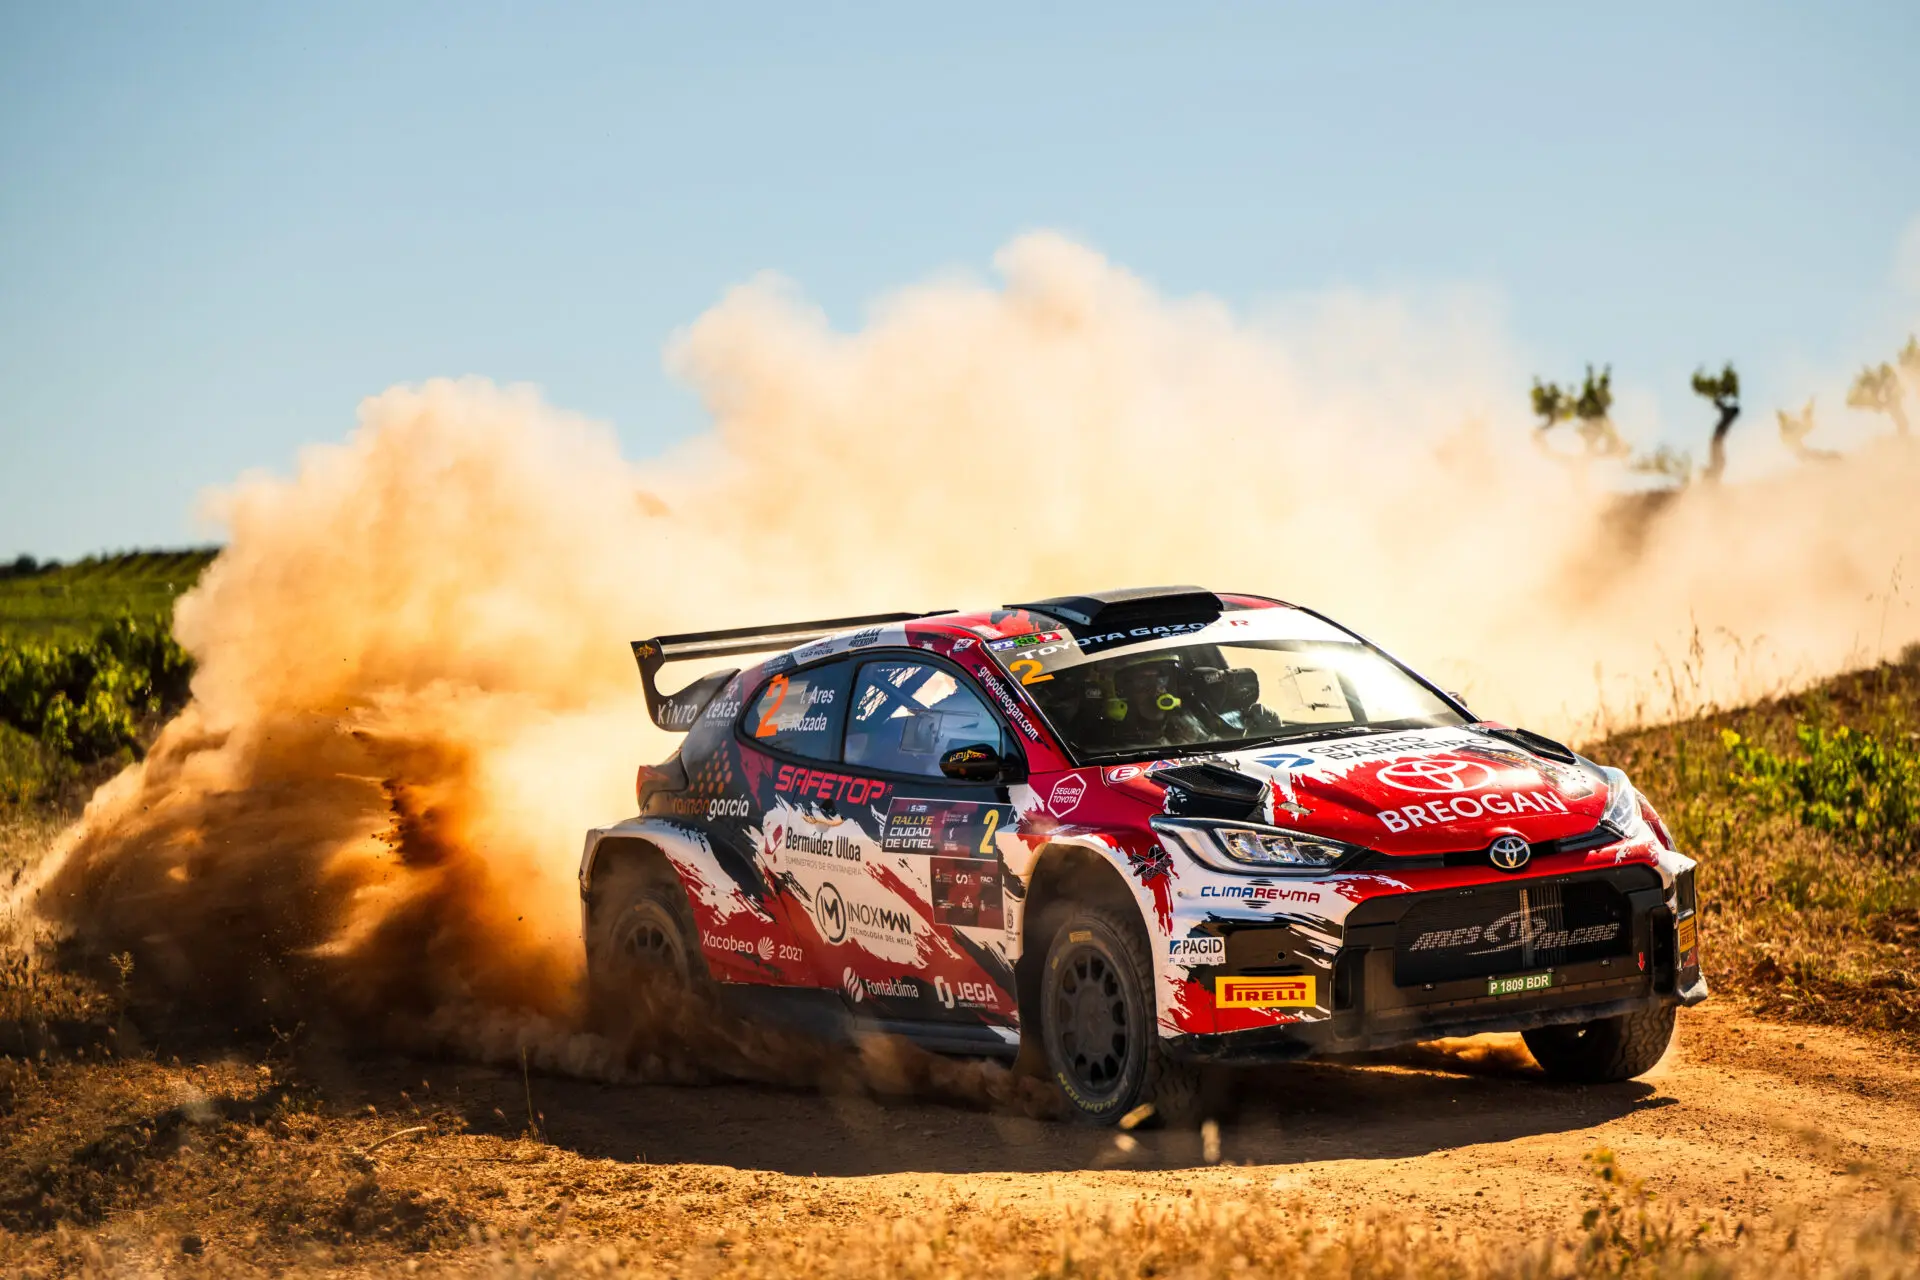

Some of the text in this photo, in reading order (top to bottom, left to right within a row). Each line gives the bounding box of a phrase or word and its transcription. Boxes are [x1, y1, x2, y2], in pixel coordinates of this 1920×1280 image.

[1016, 632, 1126, 660] TOYOTA
[1009, 659, 1055, 687] 2
[808, 686, 835, 704] Ares
[978, 666, 1039, 742] grupobreogan.com
[706, 699, 740, 719] texas
[755, 674, 790, 738] 2
[789, 712, 828, 732] Rozada
[1307, 735, 1427, 755] GRUPO
[1332, 737, 1494, 761] BARREIRO
[1115, 767, 1133, 780] E
[774, 765, 888, 806] SAFETOP
[1054, 787, 1082, 797] SEGURO
[1052, 795, 1077, 804] TOYOTA
[892, 815, 935, 825] RALLYE
[1376, 790, 1569, 834] BREOGAN
[889, 827, 932, 837] CIUDAD
[979, 809, 1000, 854] 2
[785, 826, 862, 862] Bermúdez Ulloa
[885, 838, 901, 848] DE
[902, 838, 935, 849] UTIEL
[1200, 886, 1321, 904] CLIMAREYMA
[846, 900, 912, 935] INOXMAN
[702, 929, 754, 955] Xacobeo
[1182, 939, 1223, 955] PAGID
[1168, 955, 1225, 964] RACING
[1224, 982, 1307, 1002] PIRELLI
[1490, 975, 1549, 994] P 1809 BDR
